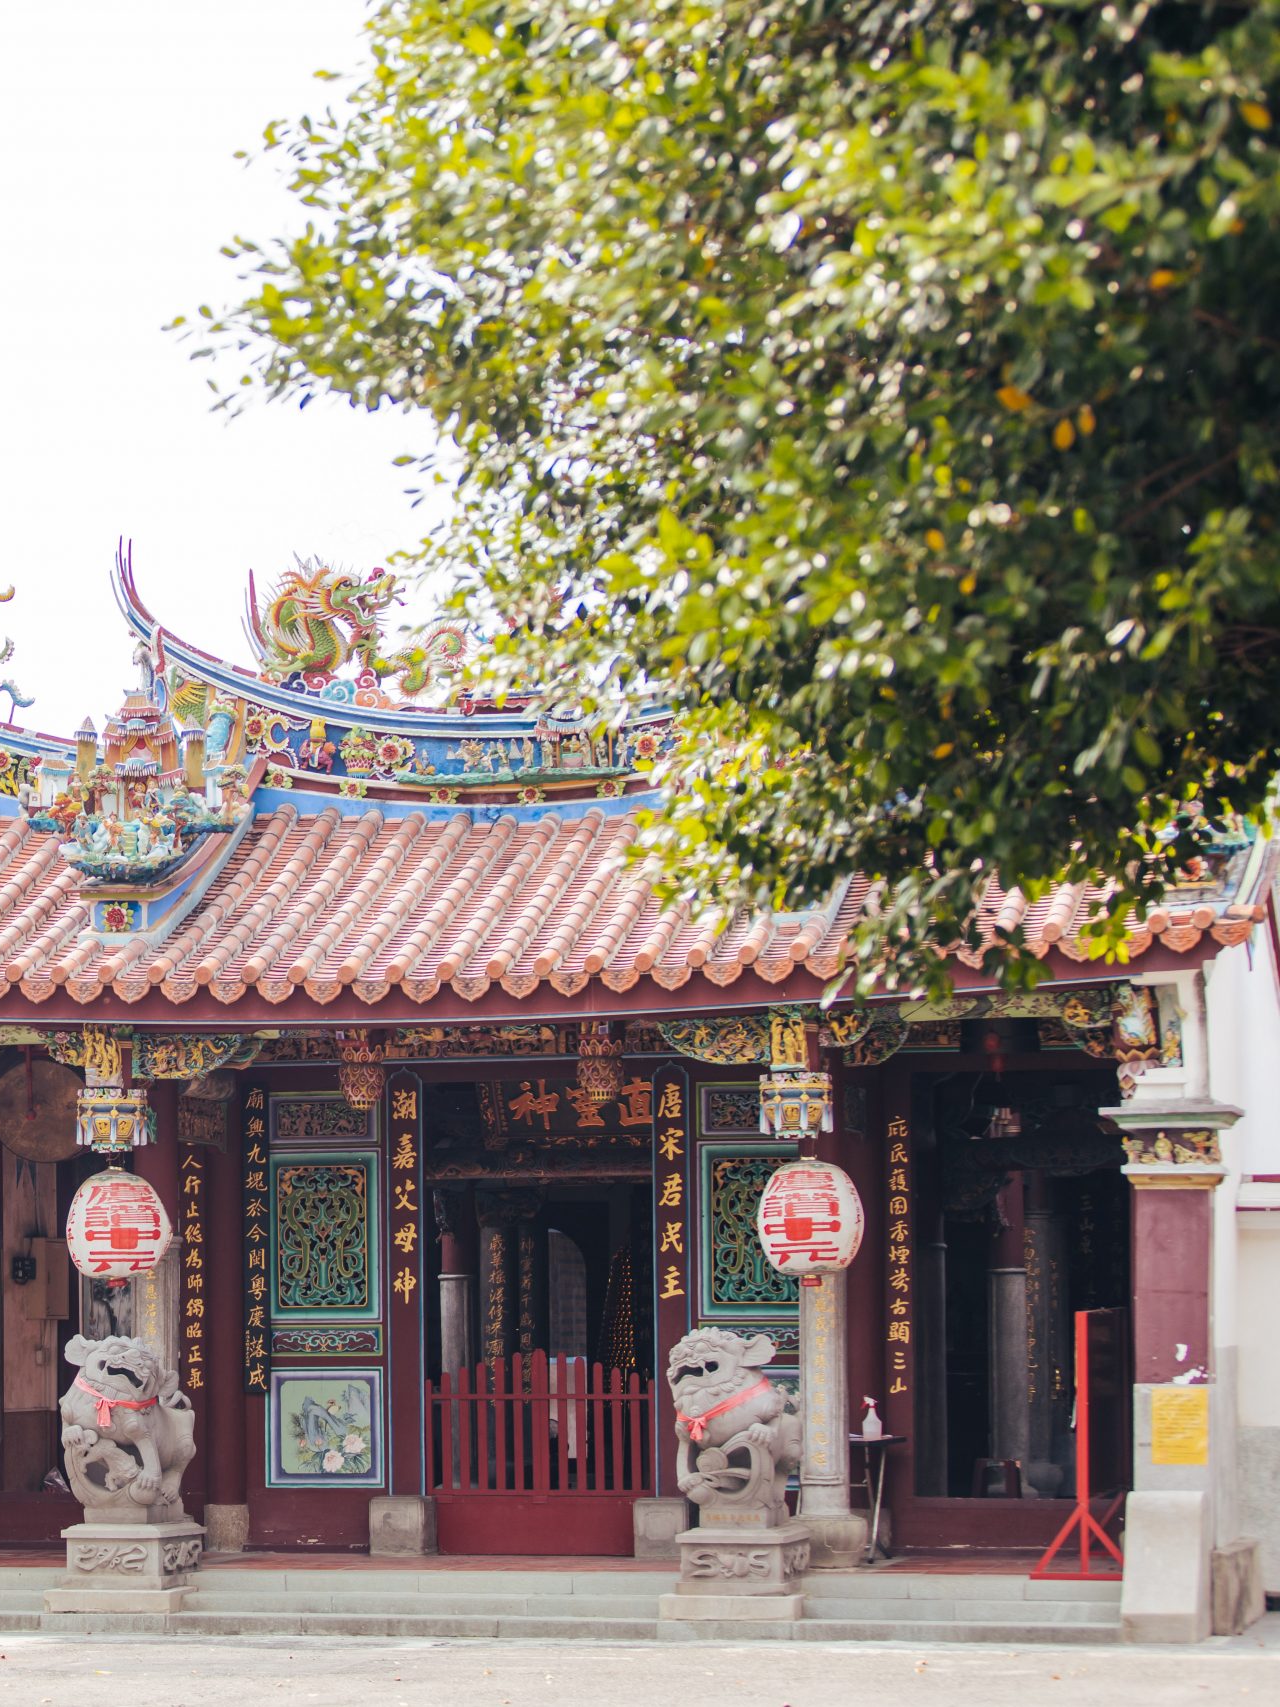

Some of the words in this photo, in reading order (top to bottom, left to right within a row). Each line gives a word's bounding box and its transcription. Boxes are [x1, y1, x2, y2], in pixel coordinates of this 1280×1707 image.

[85, 1182, 161, 1272] 慶讚中元
[392, 1089, 418, 1305] 潮嘉父母神
[658, 1083, 686, 1299] 唐宋君民主
[763, 1170, 842, 1265] 慶讚中元
